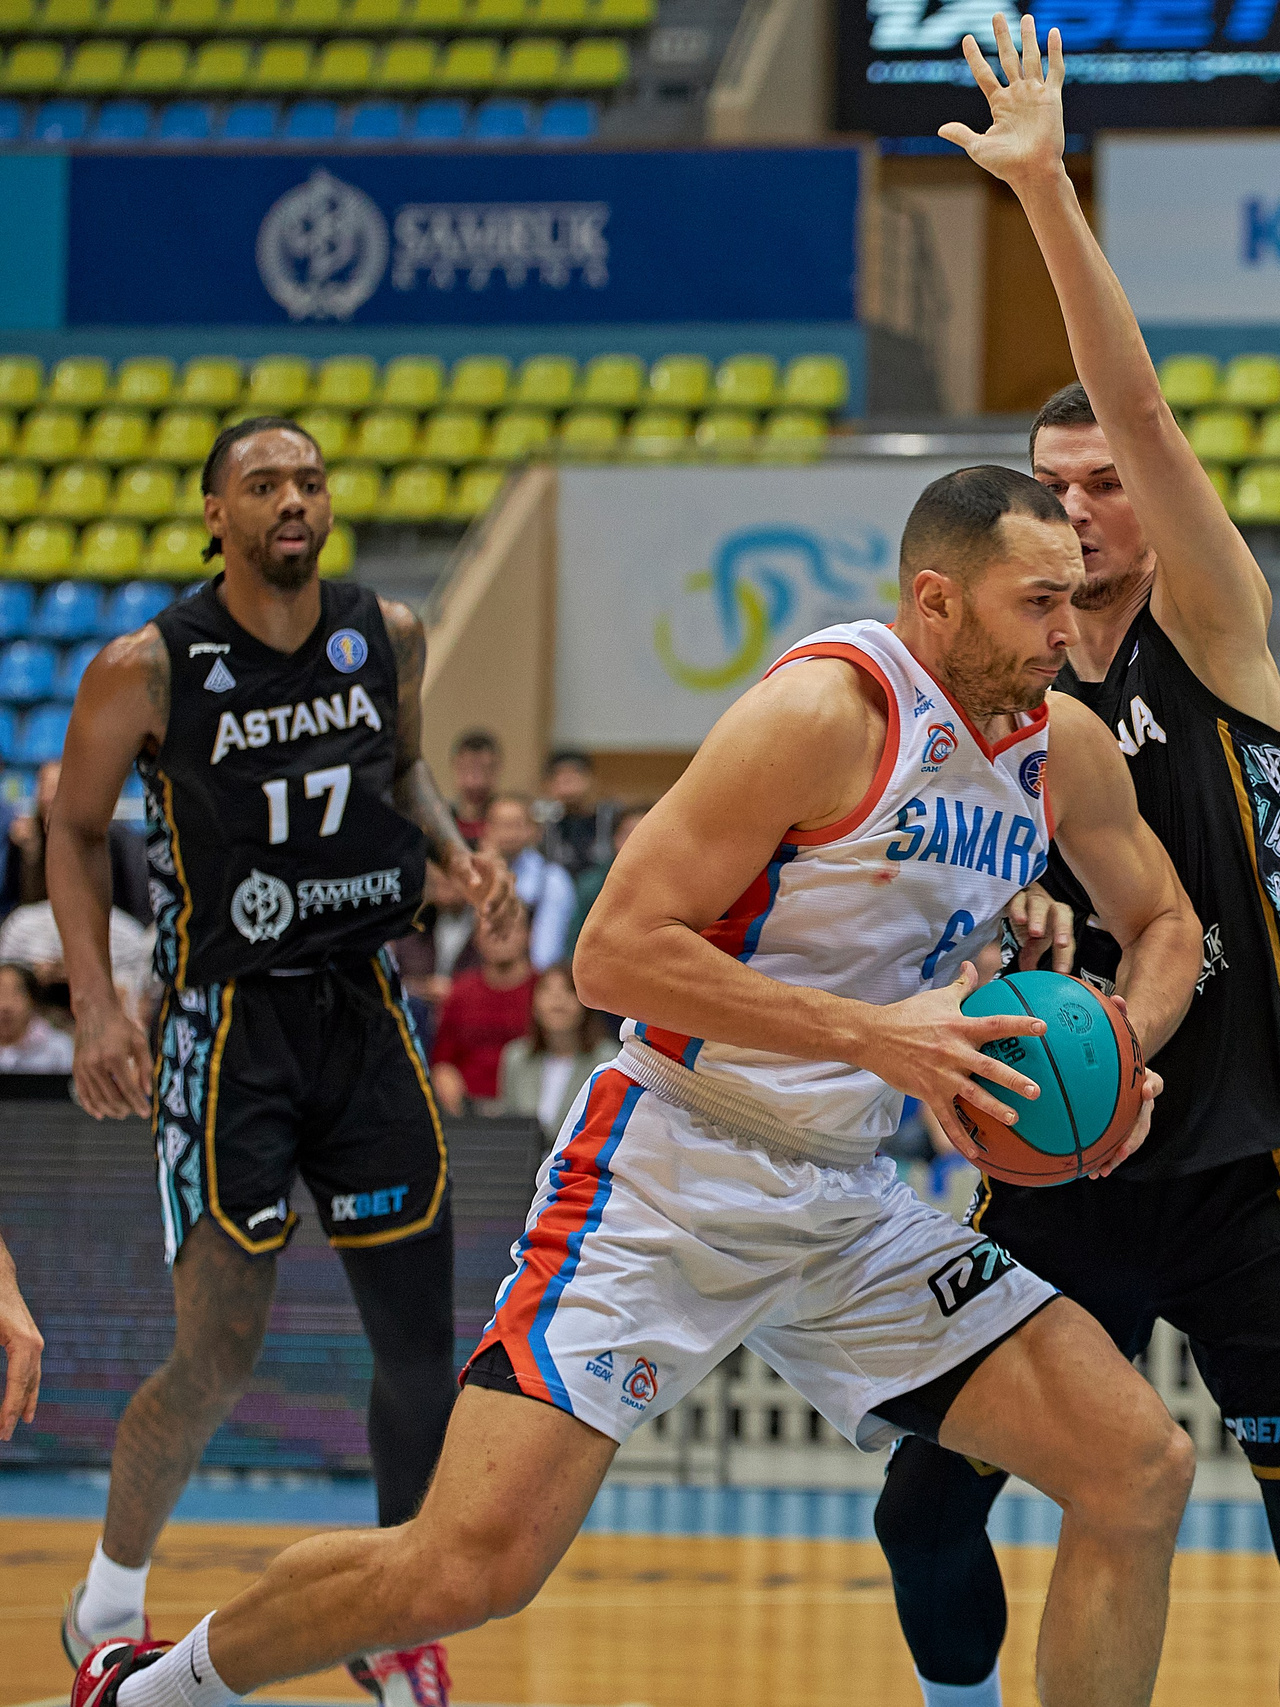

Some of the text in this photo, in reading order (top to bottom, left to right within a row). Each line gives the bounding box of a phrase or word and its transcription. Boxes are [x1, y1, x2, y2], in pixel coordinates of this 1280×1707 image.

[210, 684, 382, 765] ASTANA
[261, 763, 351, 845] 17
[297, 868, 401, 906] SAMRUK
[585, 1361, 614, 1383] PEAK
